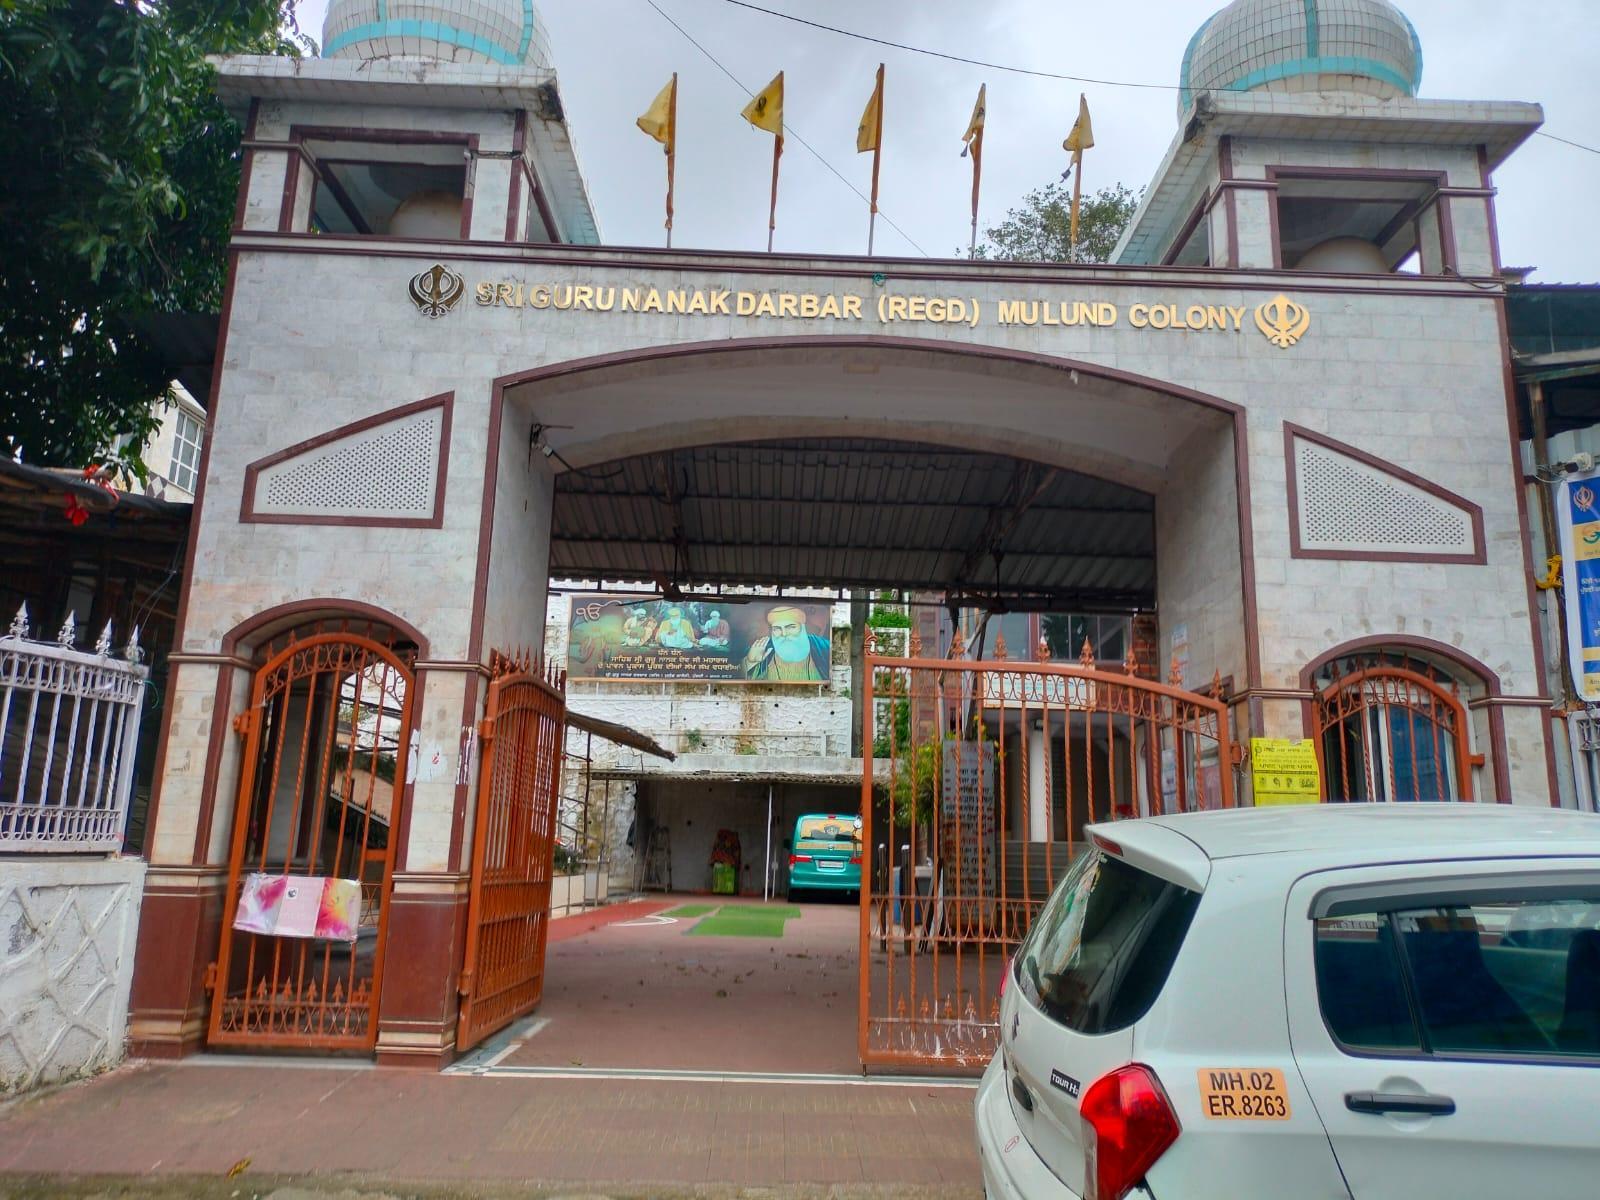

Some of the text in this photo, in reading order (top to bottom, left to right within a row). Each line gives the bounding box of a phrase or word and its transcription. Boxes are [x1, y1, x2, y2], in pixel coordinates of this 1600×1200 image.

[475, 281, 1246, 331] SRI GURU NANAK DARBAR (REGD.) MULUND COLONY
[1052, 1073, 1070, 1090] TOUR
[1209, 1071, 1276, 1091] MH.02
[1208, 1095, 1286, 1117] ER.8263
